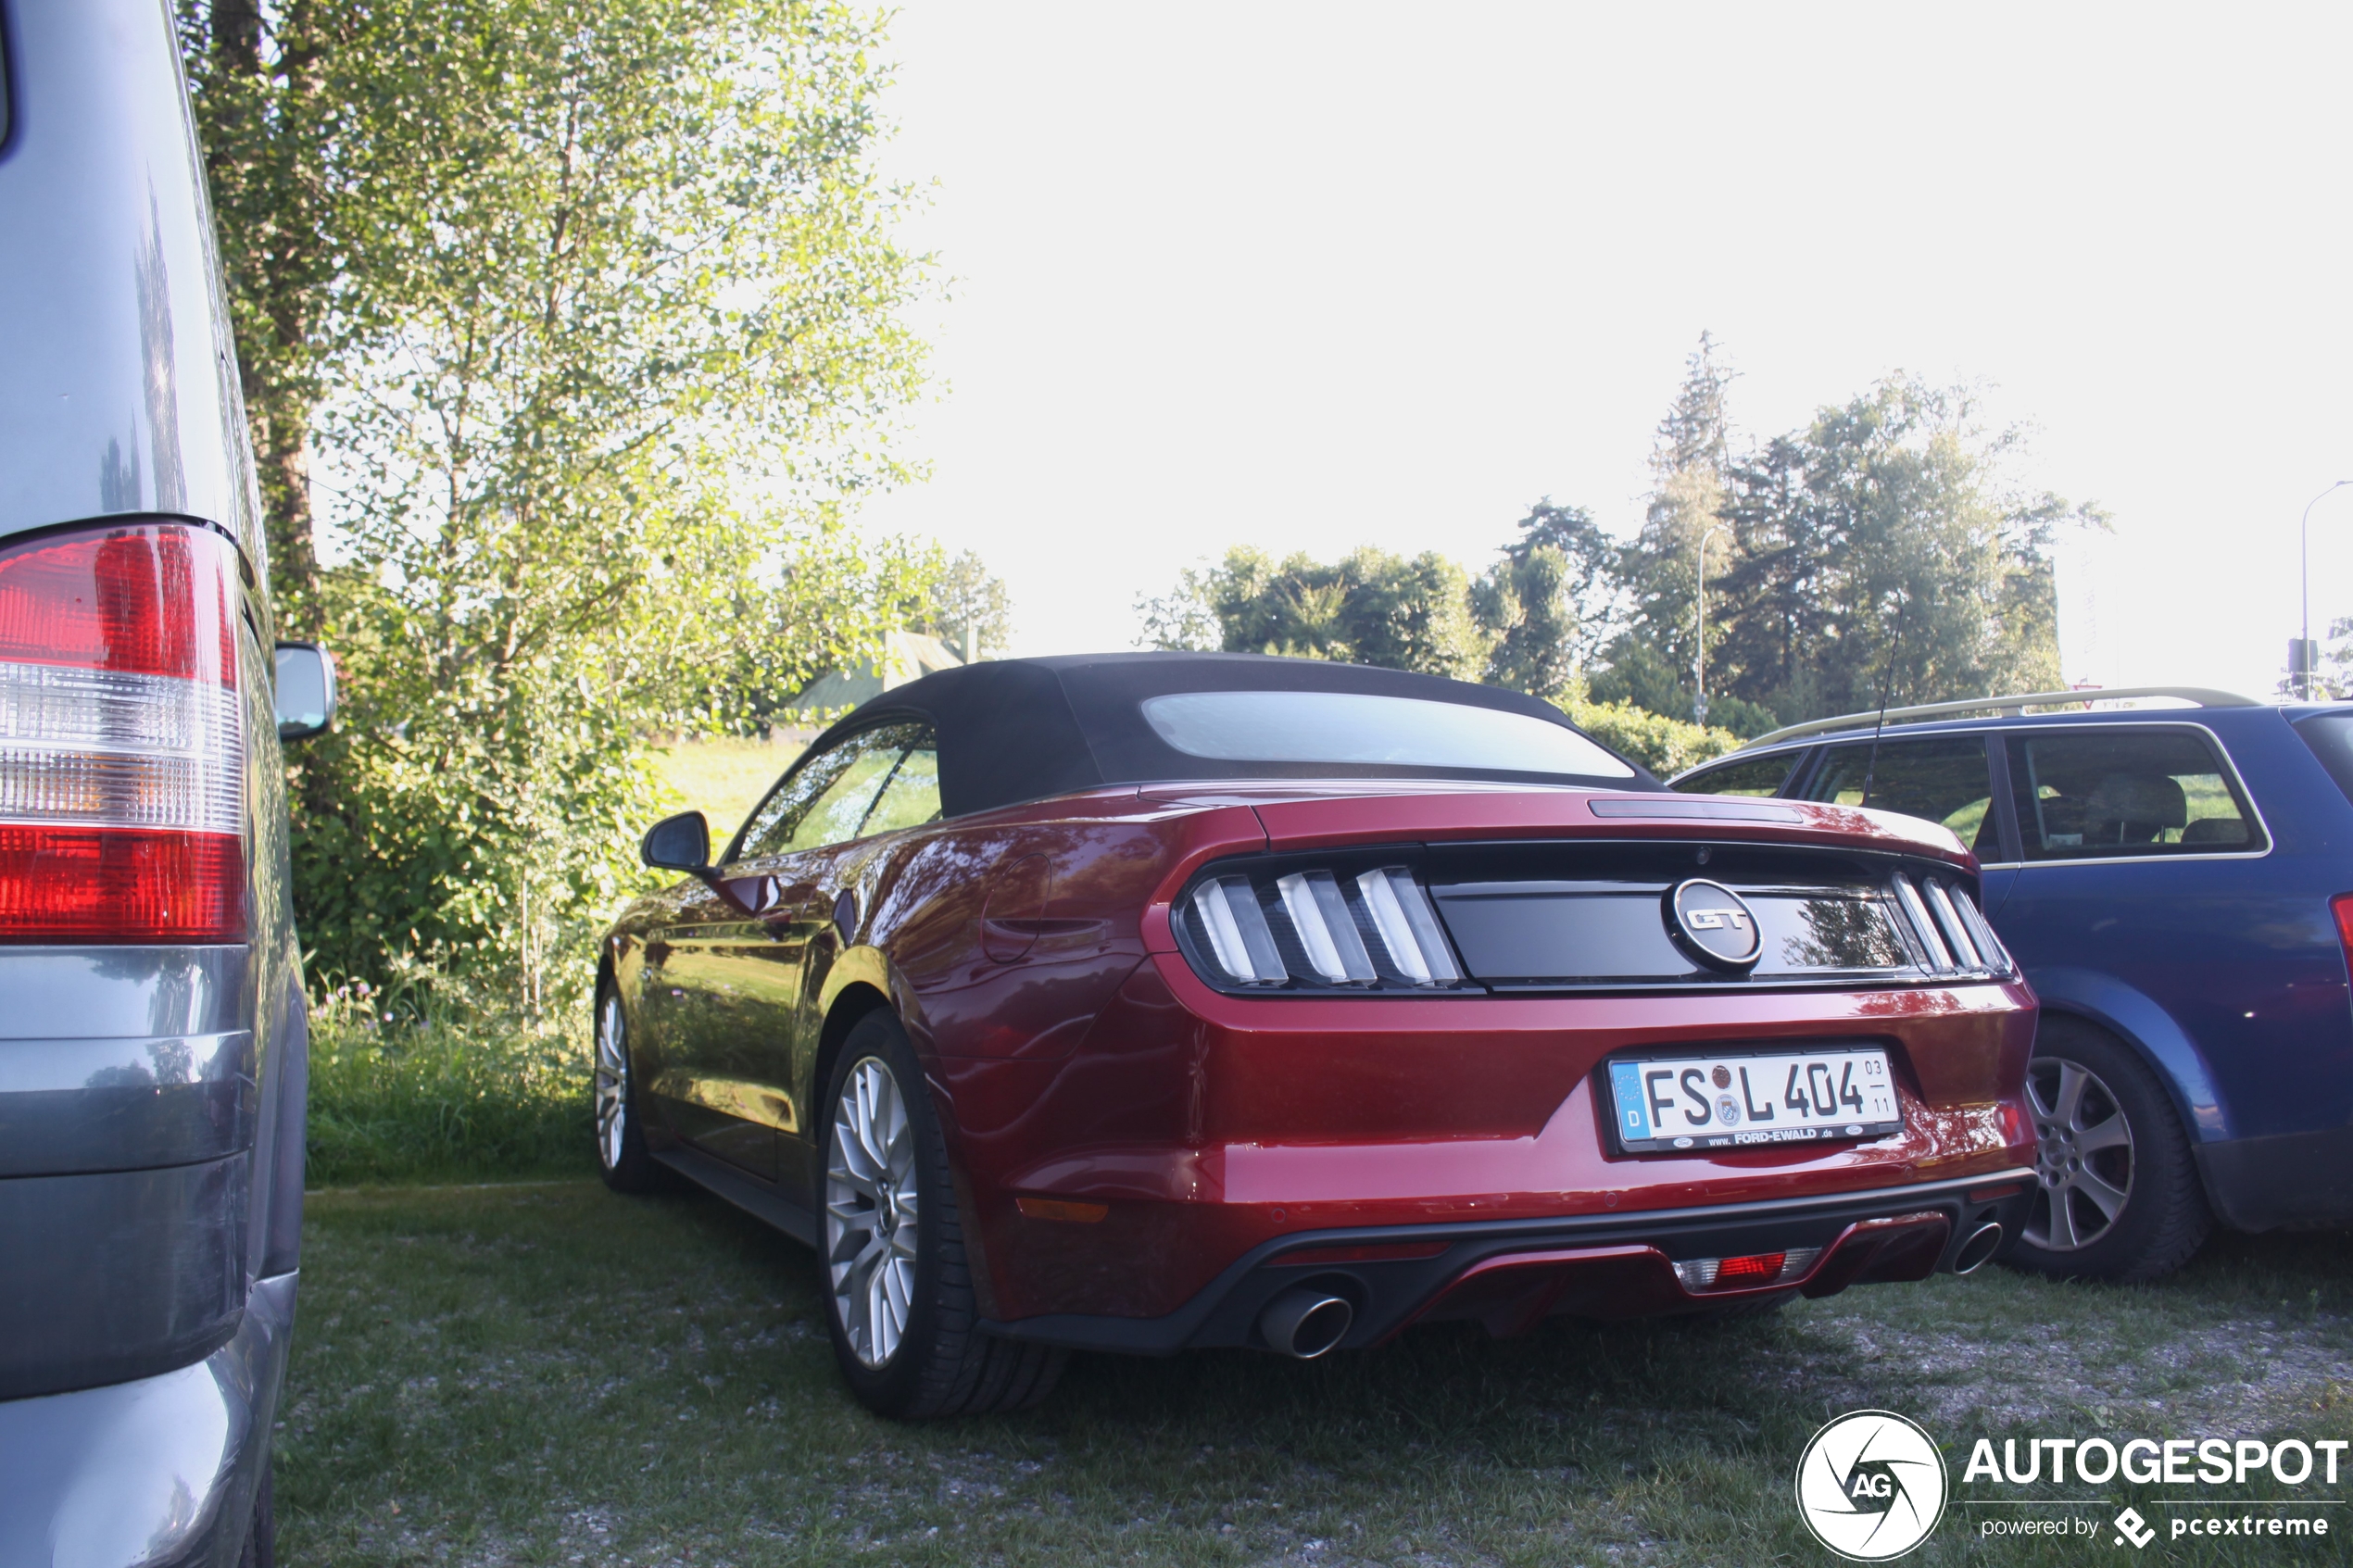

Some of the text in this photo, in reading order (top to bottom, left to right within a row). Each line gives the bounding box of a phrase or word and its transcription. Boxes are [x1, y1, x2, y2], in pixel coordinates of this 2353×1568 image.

[1686, 909, 1746, 930] GT
[1865, 1060, 1881, 1074] 03
[1645, 1068, 1712, 1127] FS
[1739, 1066, 1774, 1121] L
[1784, 1061, 1863, 1117] 404
[1874, 1098, 1890, 1113] 11
[1629, 1110, 1640, 1127] D
[1734, 1129, 1817, 1144] FORD-EWALD
